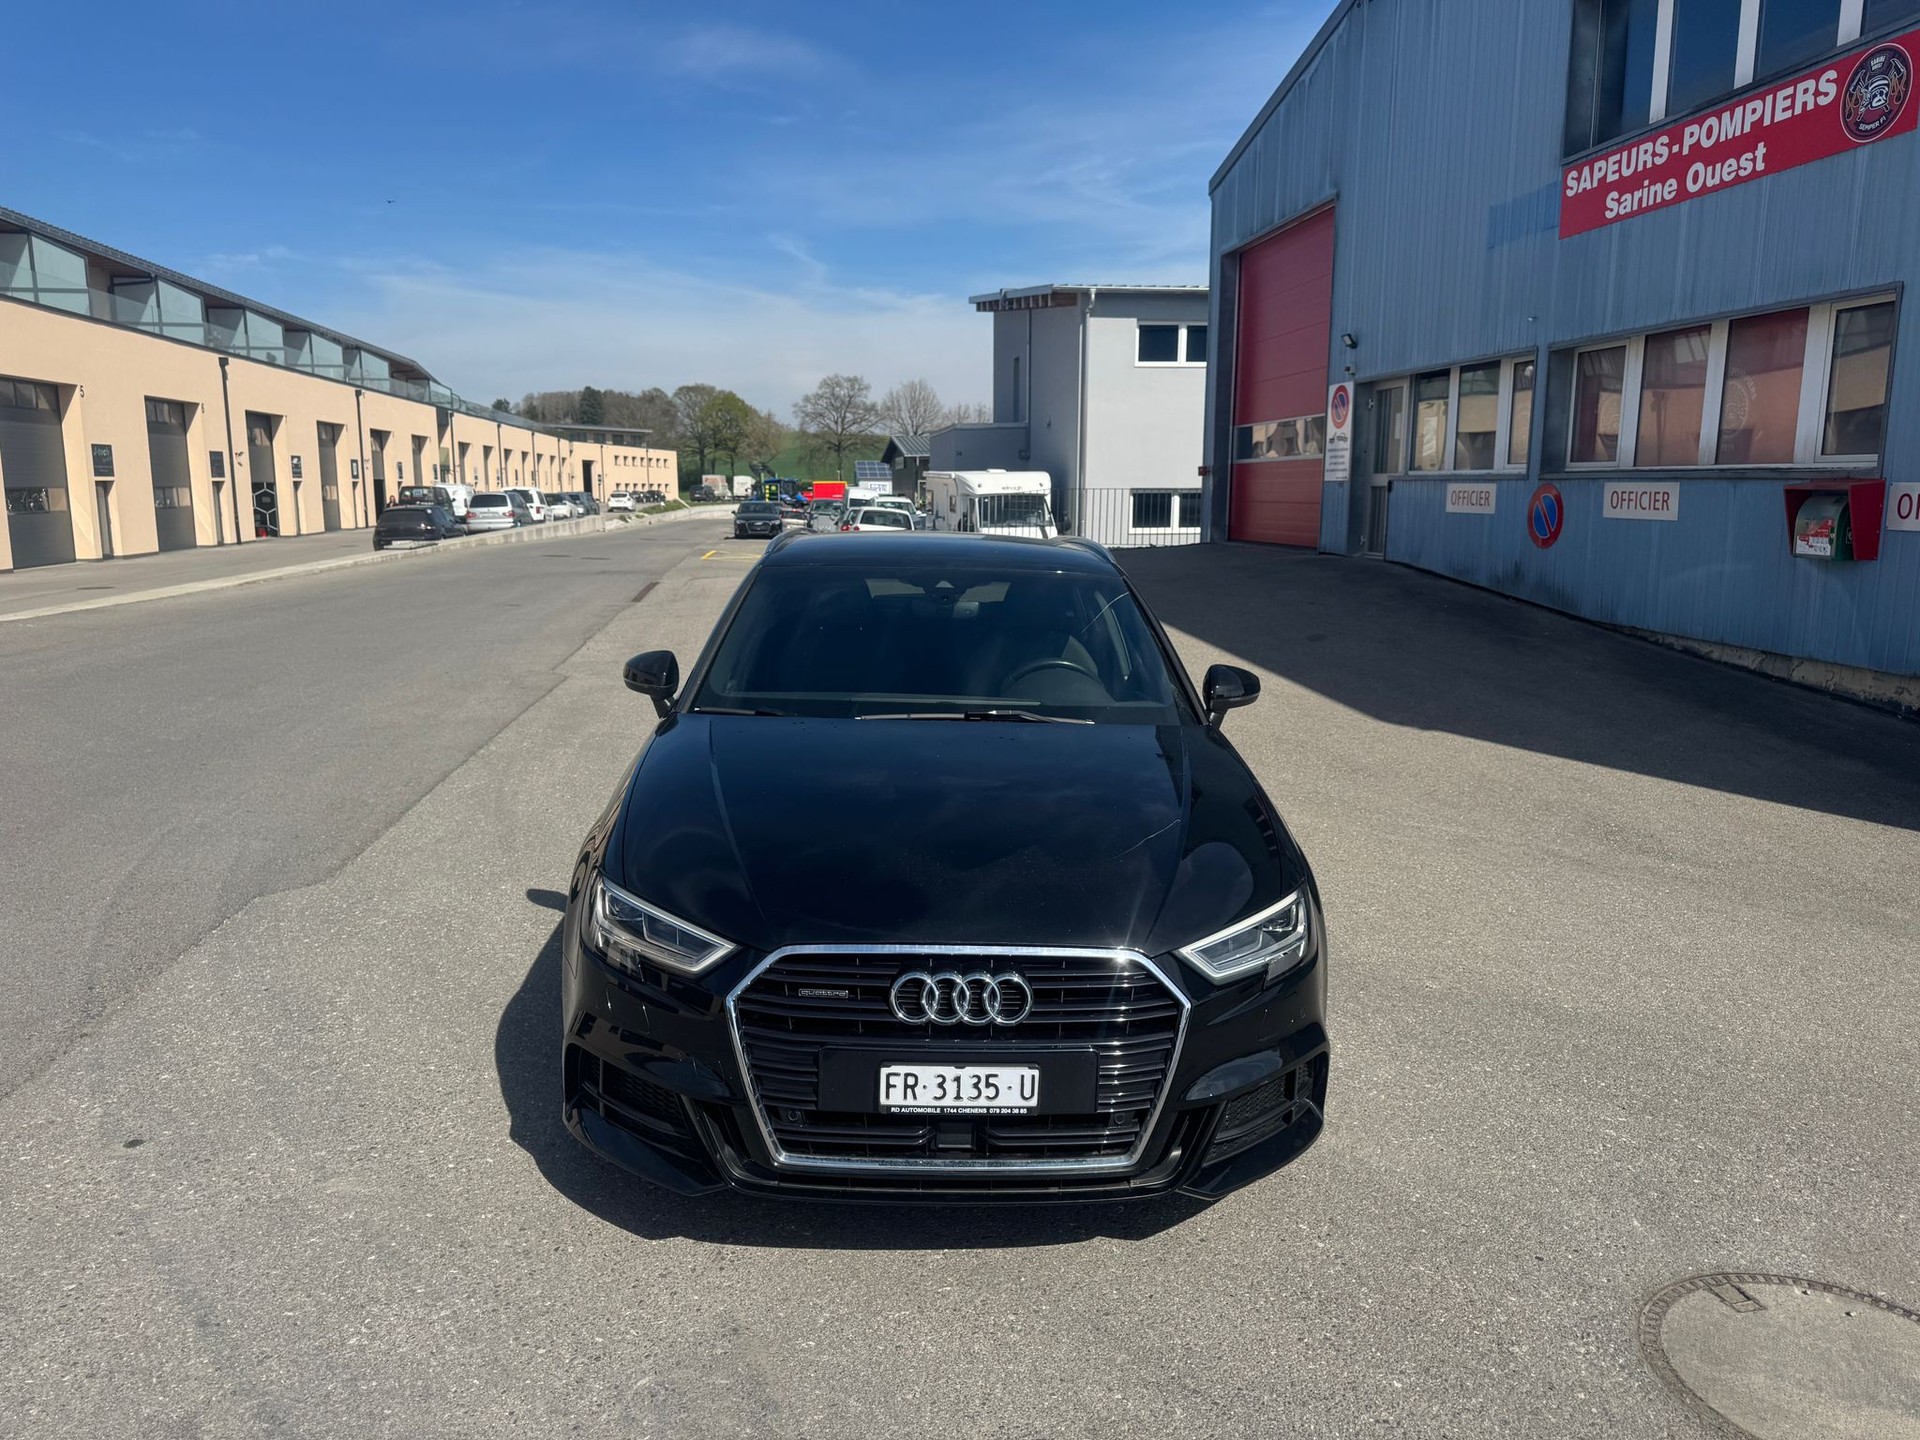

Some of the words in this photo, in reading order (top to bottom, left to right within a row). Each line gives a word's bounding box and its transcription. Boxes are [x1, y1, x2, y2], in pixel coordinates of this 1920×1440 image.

[1565, 69, 1838, 197] SAPEURS-POMPIERS
[1604, 179, 1678, 219] Sarine
[1685, 141, 1767, 193] Ouest
[79, 384, 85, 398] 5
[1450, 490, 1491, 507] OFFICIER
[1610, 490, 1670, 511] OFFICIER
